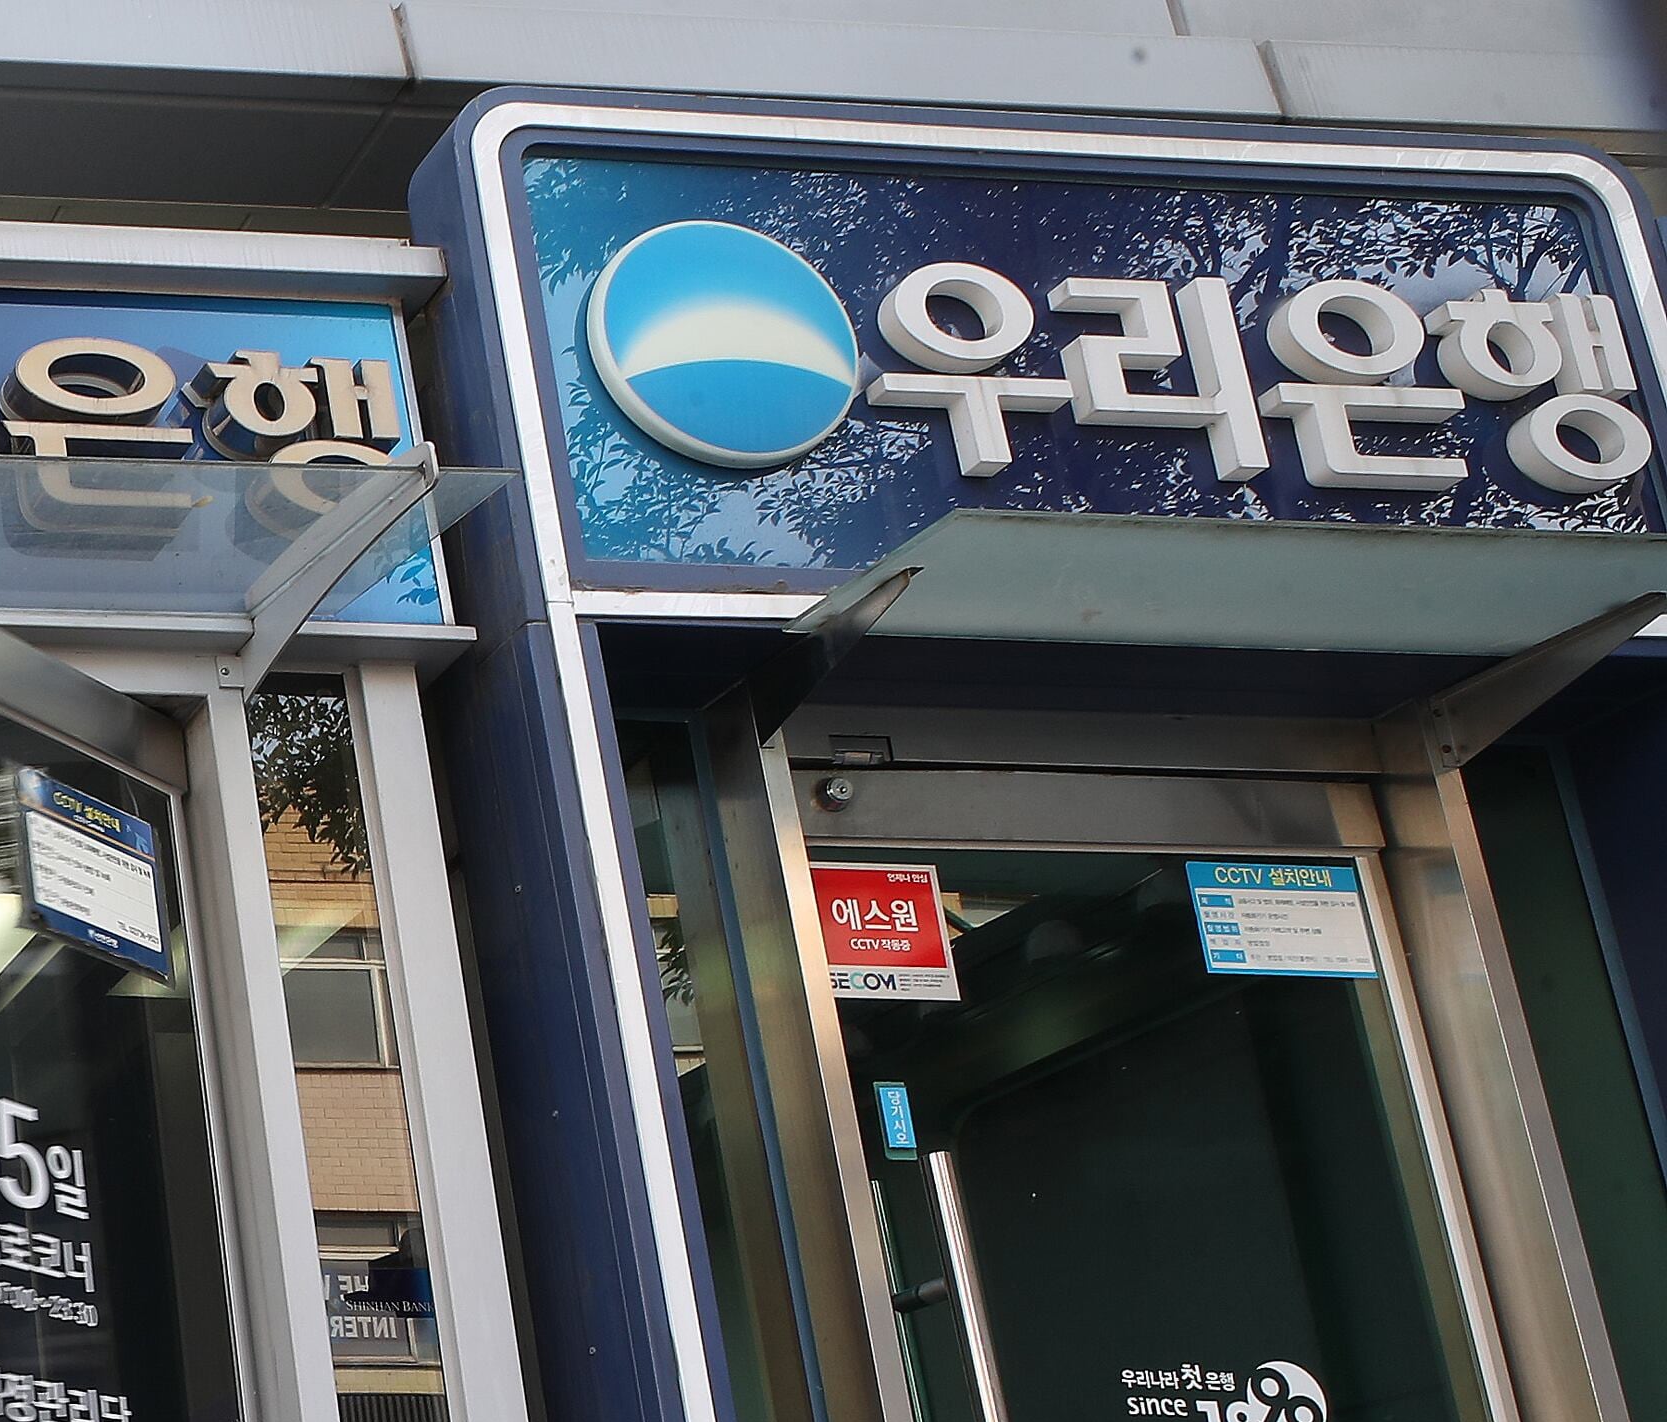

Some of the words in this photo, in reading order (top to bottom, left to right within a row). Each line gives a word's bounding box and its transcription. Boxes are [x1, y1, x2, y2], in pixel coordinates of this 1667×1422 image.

[867, 261, 1653, 492] 우리은행
[1213, 866, 1262, 885] CCTV
[1267, 867, 1333, 888] 설치안내
[831, 898, 919, 933] 에스원
[850, 938, 880, 951] CCTV
[886, 1090, 910, 1145] 당기시오
[346, 1300, 400, 1312] SHINHAN
[1121, 1369, 1180, 1389] 우리나라
[1180, 1363, 1203, 1391] 첫
[1205, 1371, 1236, 1393] 은행
[1126, 1396, 1188, 1417] since
